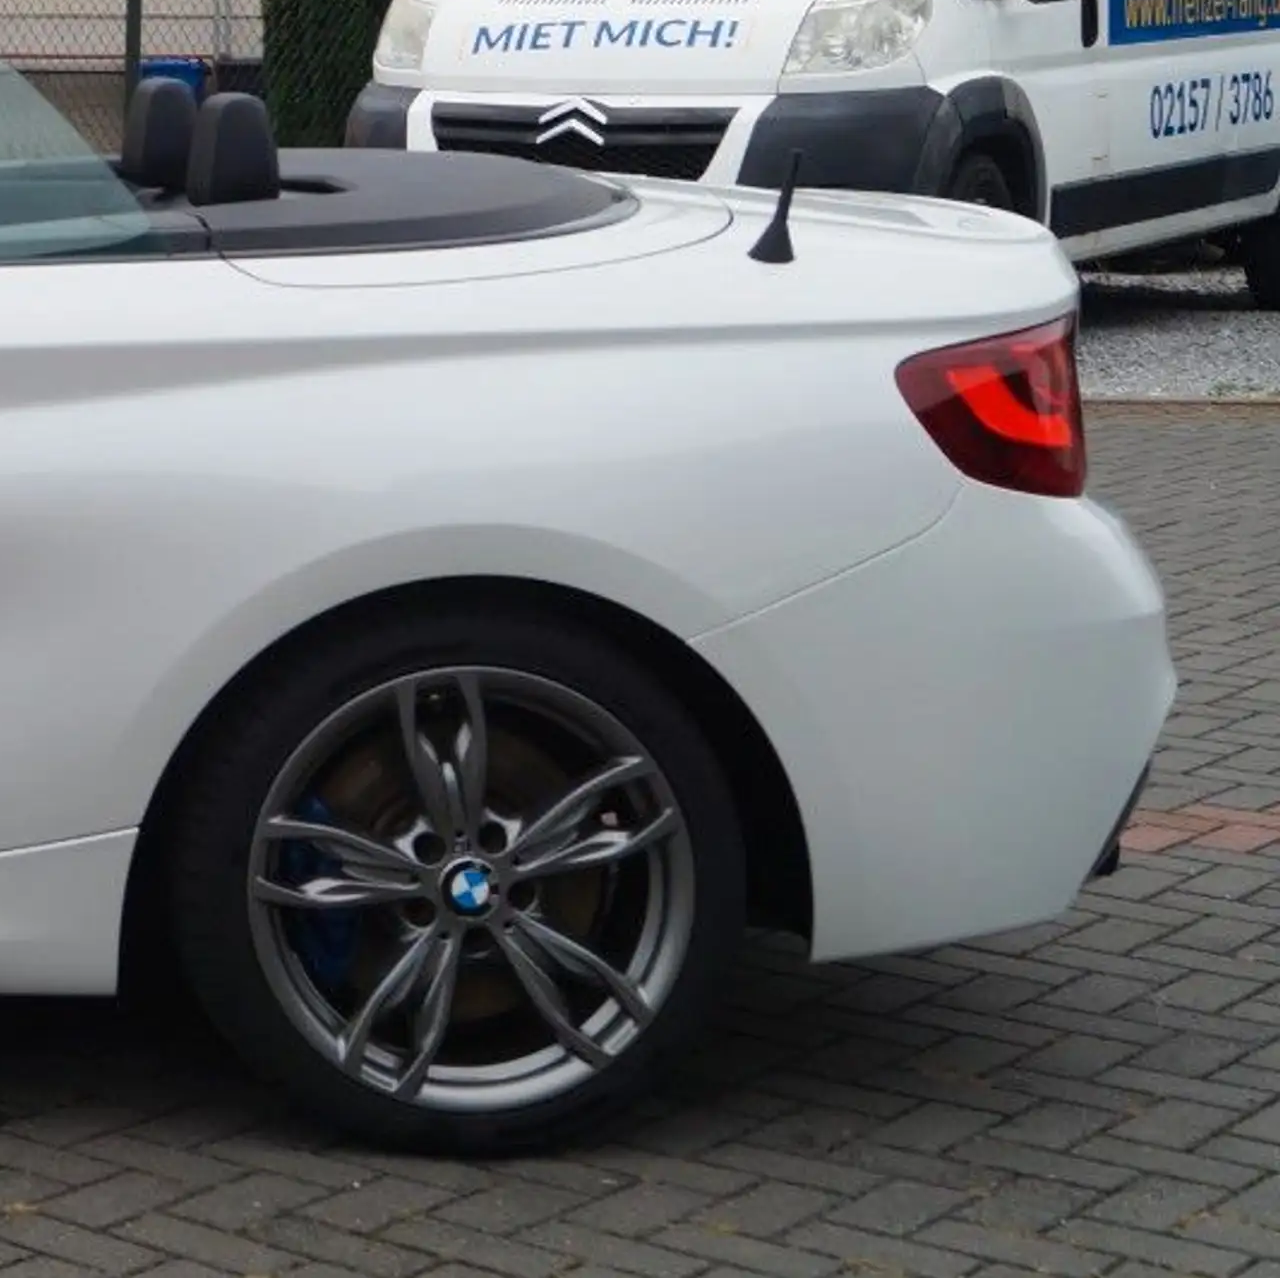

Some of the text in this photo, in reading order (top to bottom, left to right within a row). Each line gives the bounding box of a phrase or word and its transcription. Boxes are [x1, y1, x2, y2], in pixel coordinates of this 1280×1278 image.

[472, 19, 739, 55] MIET MICH!
[1150, 77, 1211, 139] 02157
[1229, 70, 1274, 125] 3786
